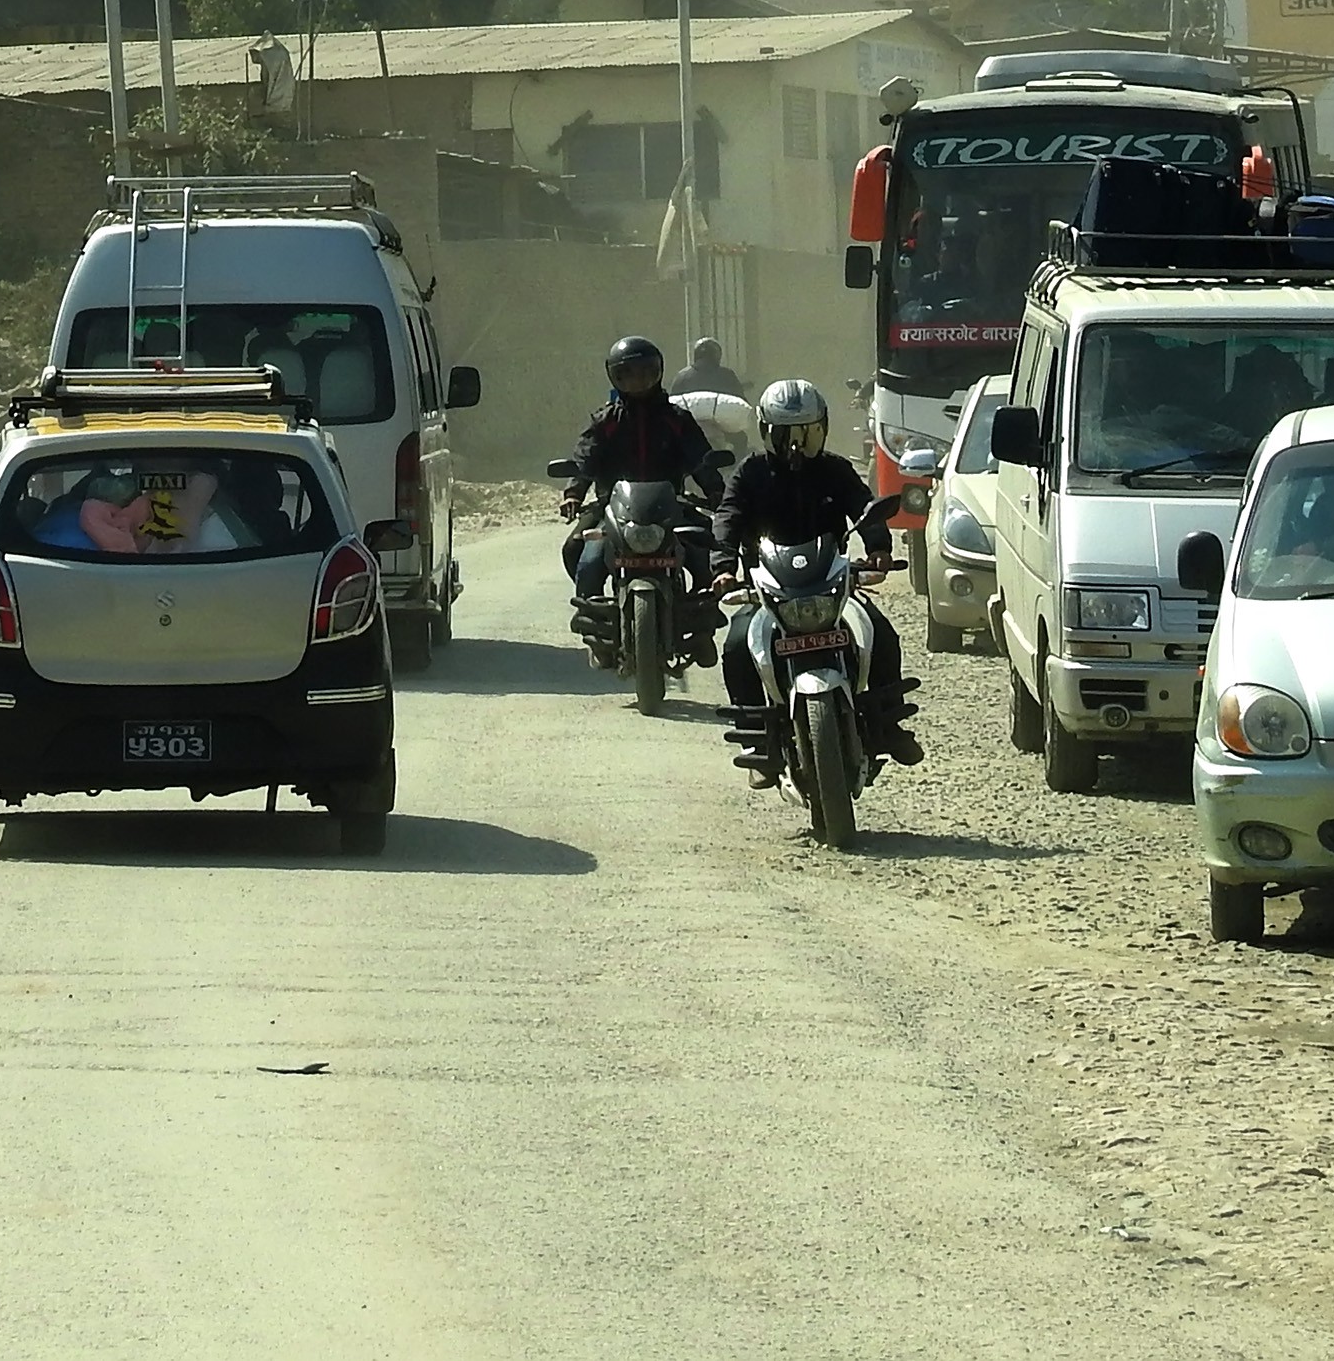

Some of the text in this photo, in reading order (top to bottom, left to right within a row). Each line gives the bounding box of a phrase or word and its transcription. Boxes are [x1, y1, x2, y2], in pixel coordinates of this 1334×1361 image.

[929, 134, 1211, 164] TOURIST
[143, 475, 183, 488] TAXI
[128, 737, 206, 757] ५३०३
